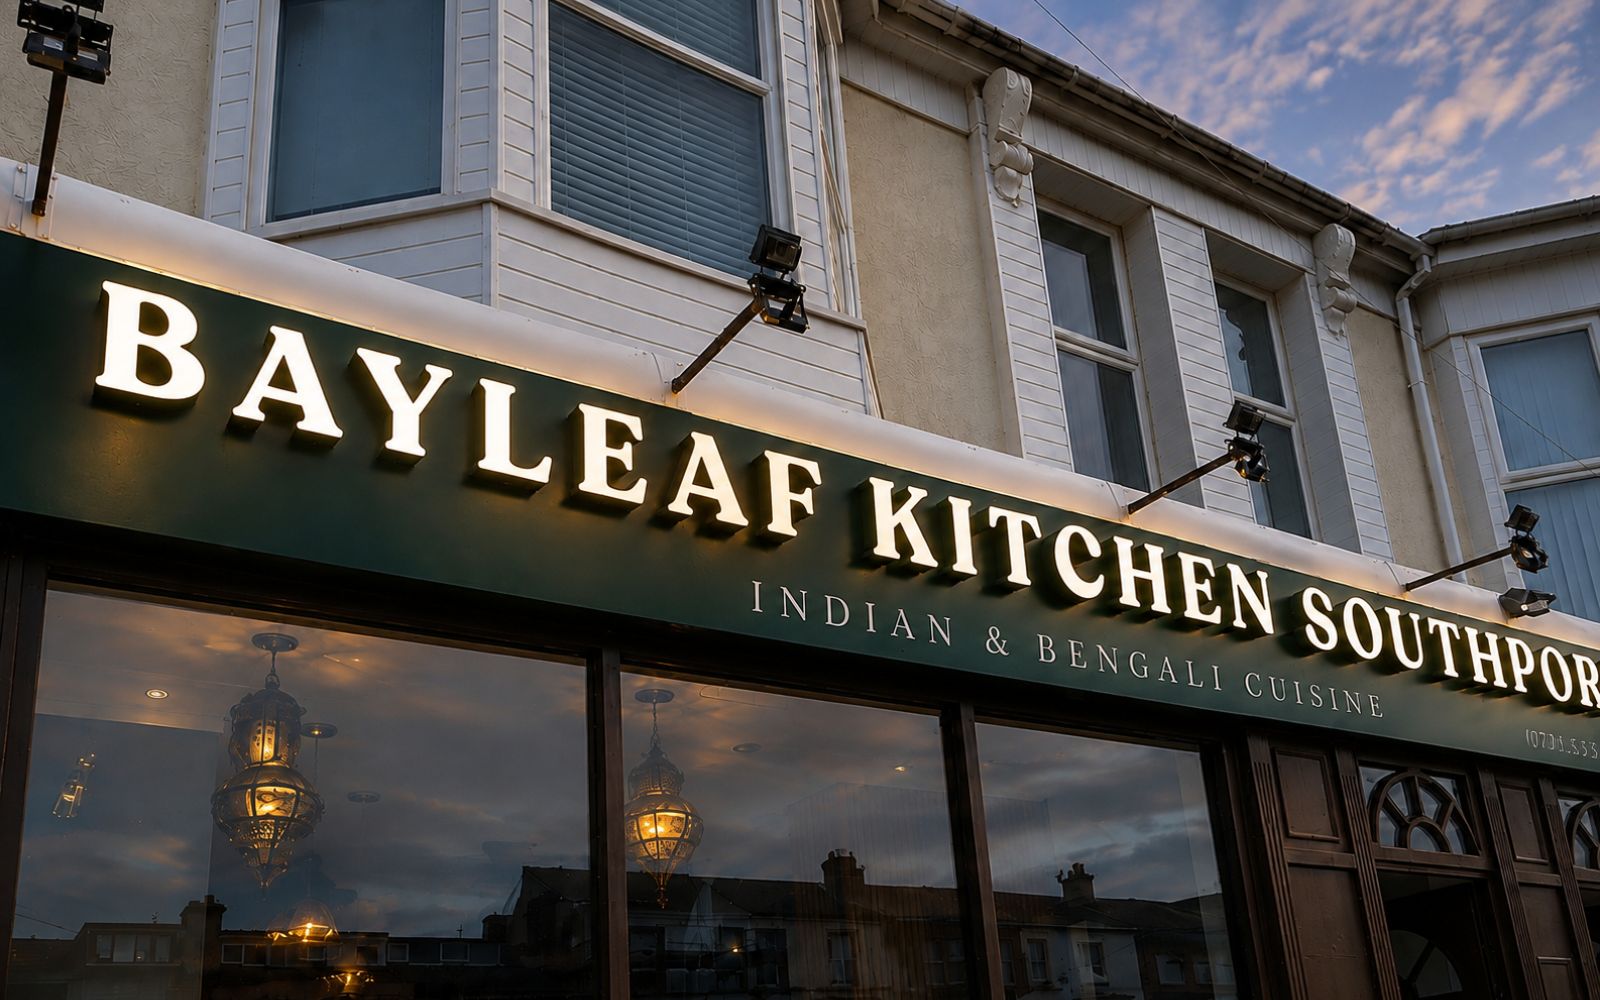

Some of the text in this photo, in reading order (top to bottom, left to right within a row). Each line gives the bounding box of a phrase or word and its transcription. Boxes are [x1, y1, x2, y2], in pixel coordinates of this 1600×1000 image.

[94, 280, 1600, 709] BAYLEAF KITCHEN SOUTHPOR
[751, 580, 1384, 719] INDIAN & BENGALI CUISINE
